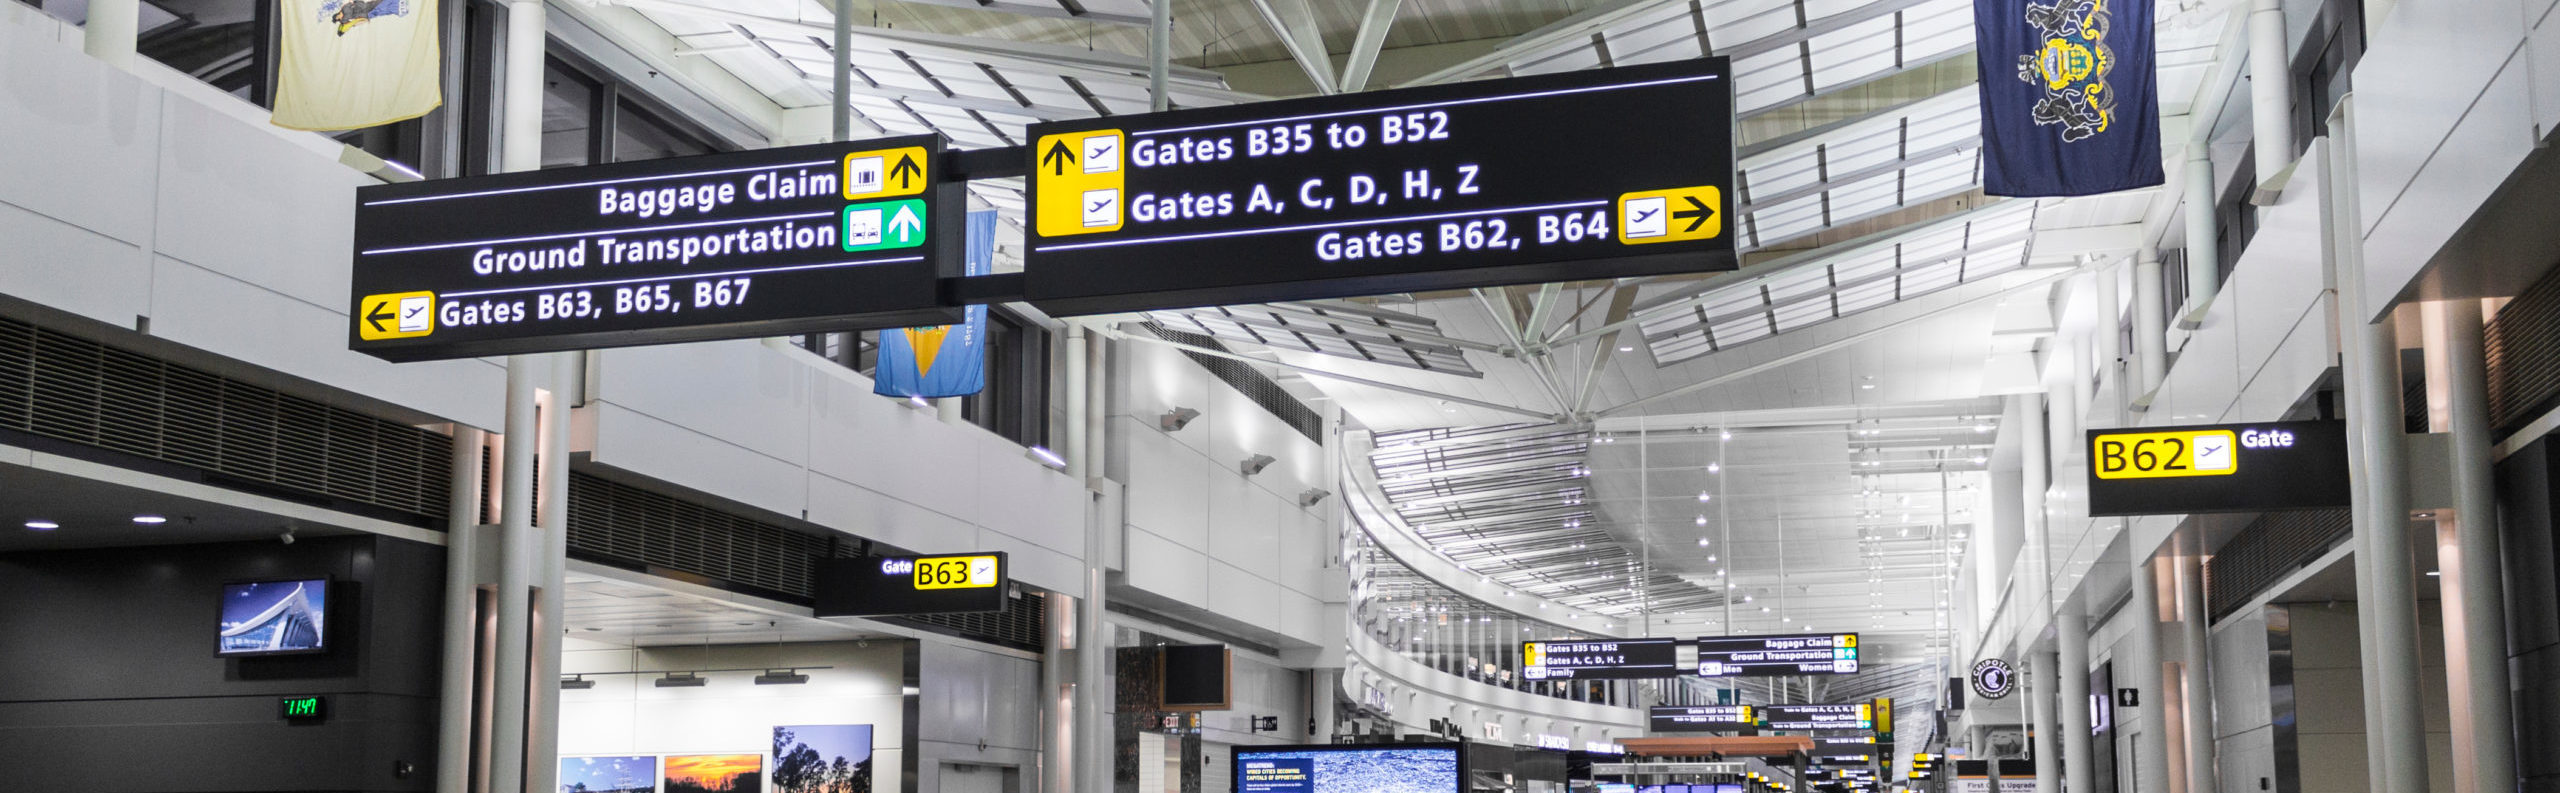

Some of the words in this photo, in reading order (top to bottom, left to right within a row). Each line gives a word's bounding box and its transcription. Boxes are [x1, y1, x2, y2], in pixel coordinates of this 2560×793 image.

[1133, 138, 1232, 166] Gates
[1250, 125, 1311, 155] B35
[1328, 124, 1365, 148] to
[1384, 112, 1448, 143] B52
[600, 184, 734, 217] Baggage
[748, 170, 837, 200] Claim
[1133, 193, 1232, 221] Gates
[1248, 185, 1283, 213] A,
[1301, 180, 1332, 208] C,
[1351, 176, 1386, 204] D,
[1406, 170, 1441, 199] H,
[1459, 166, 1478, 193] Z
[474, 240, 586, 274] Ground
[598, 222, 836, 264] Transportation
[1318, 232, 1422, 260] Gates
[1441, 220, 1520, 250] B62,
[1540, 212, 1609, 243] B64
[440, 301, 525, 327] Gates
[539, 292, 601, 319] B63,
[617, 285, 680, 313] B65,
[696, 279, 750, 307] B67
[2241, 430, 2294, 449] Gate
[2101, 438, 2188, 473] B62
[882, 559, 912, 574] Gate
[918, 561, 968, 586] B63
[1731, 652, 1764, 661] Ground
[1767, 651, 1832, 661] Transportation
[1766, 640, 1804, 649] Baggage
[1807, 638, 1832, 647] Claim
[1547, 669, 1574, 677] Family
[1973, 660, 2012, 677] CHIPOTLE
